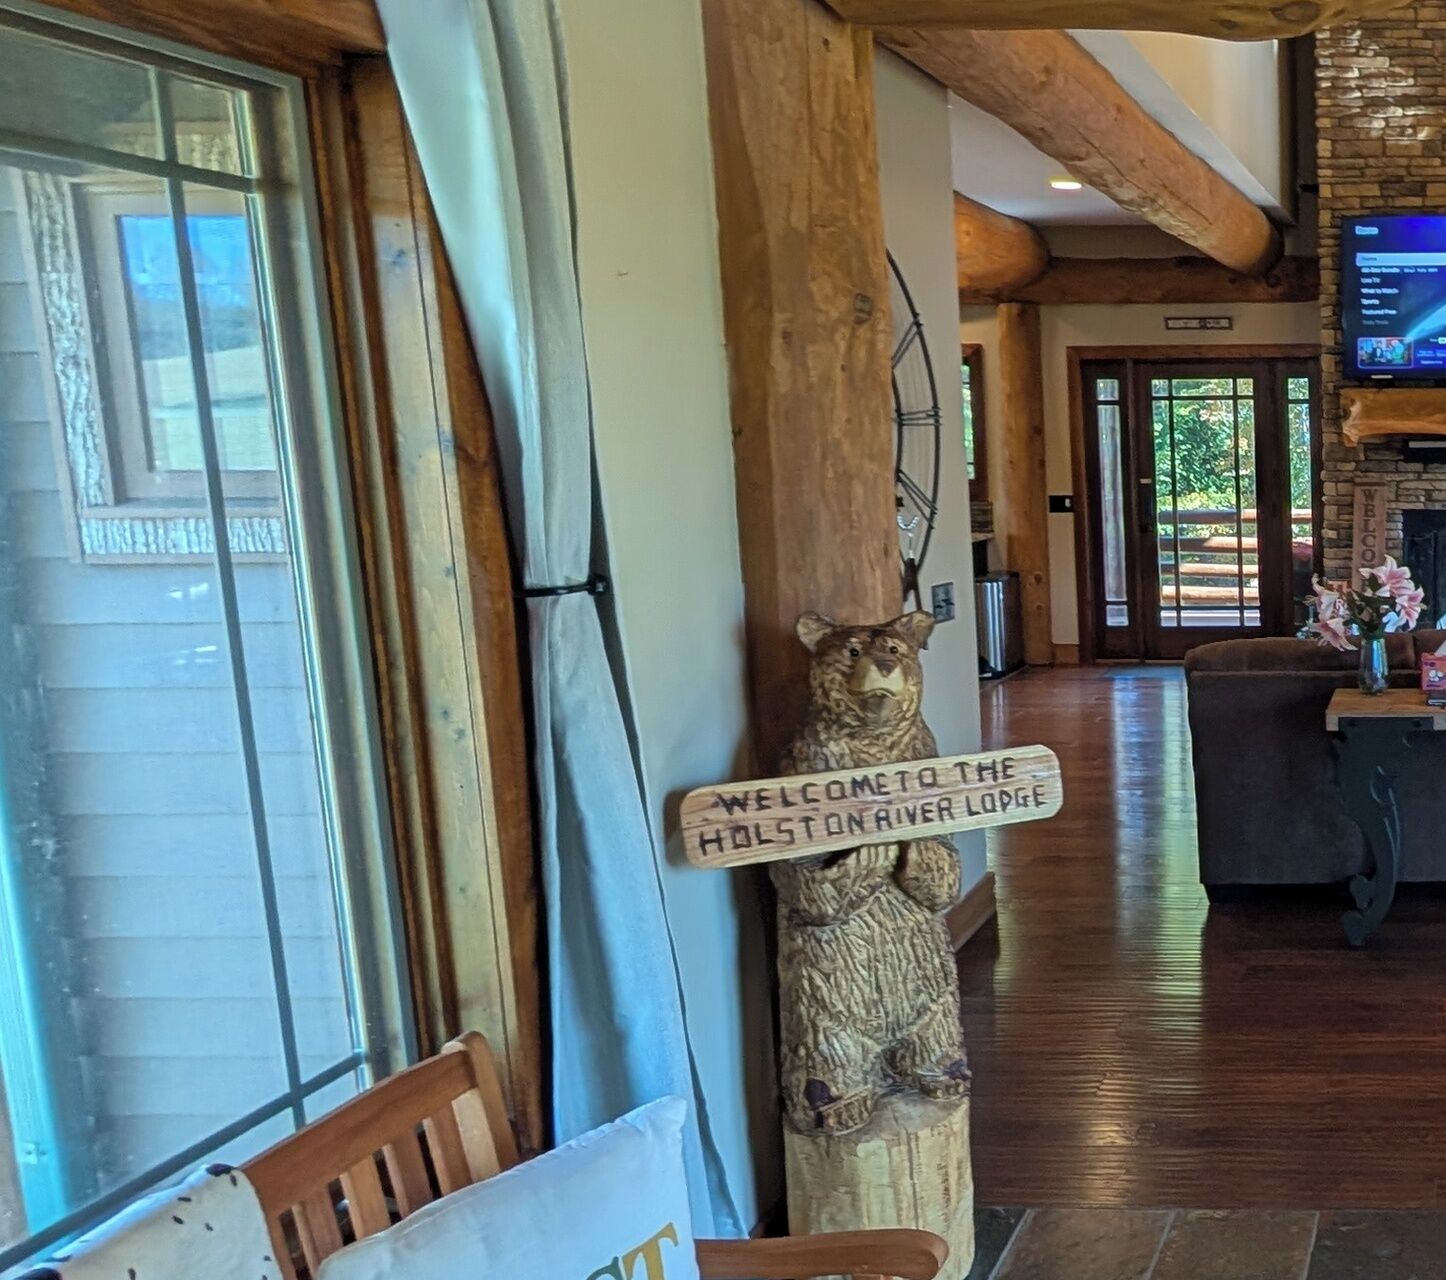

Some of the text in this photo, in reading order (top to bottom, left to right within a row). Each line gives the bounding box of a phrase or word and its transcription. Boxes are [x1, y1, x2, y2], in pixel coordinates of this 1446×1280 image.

[1361, 488, 1378, 568] WELCO
[699, 784, 1048, 856] HOLSTON RIVER LODGE
[716, 757, 1016, 816] WELCOME TO THE
